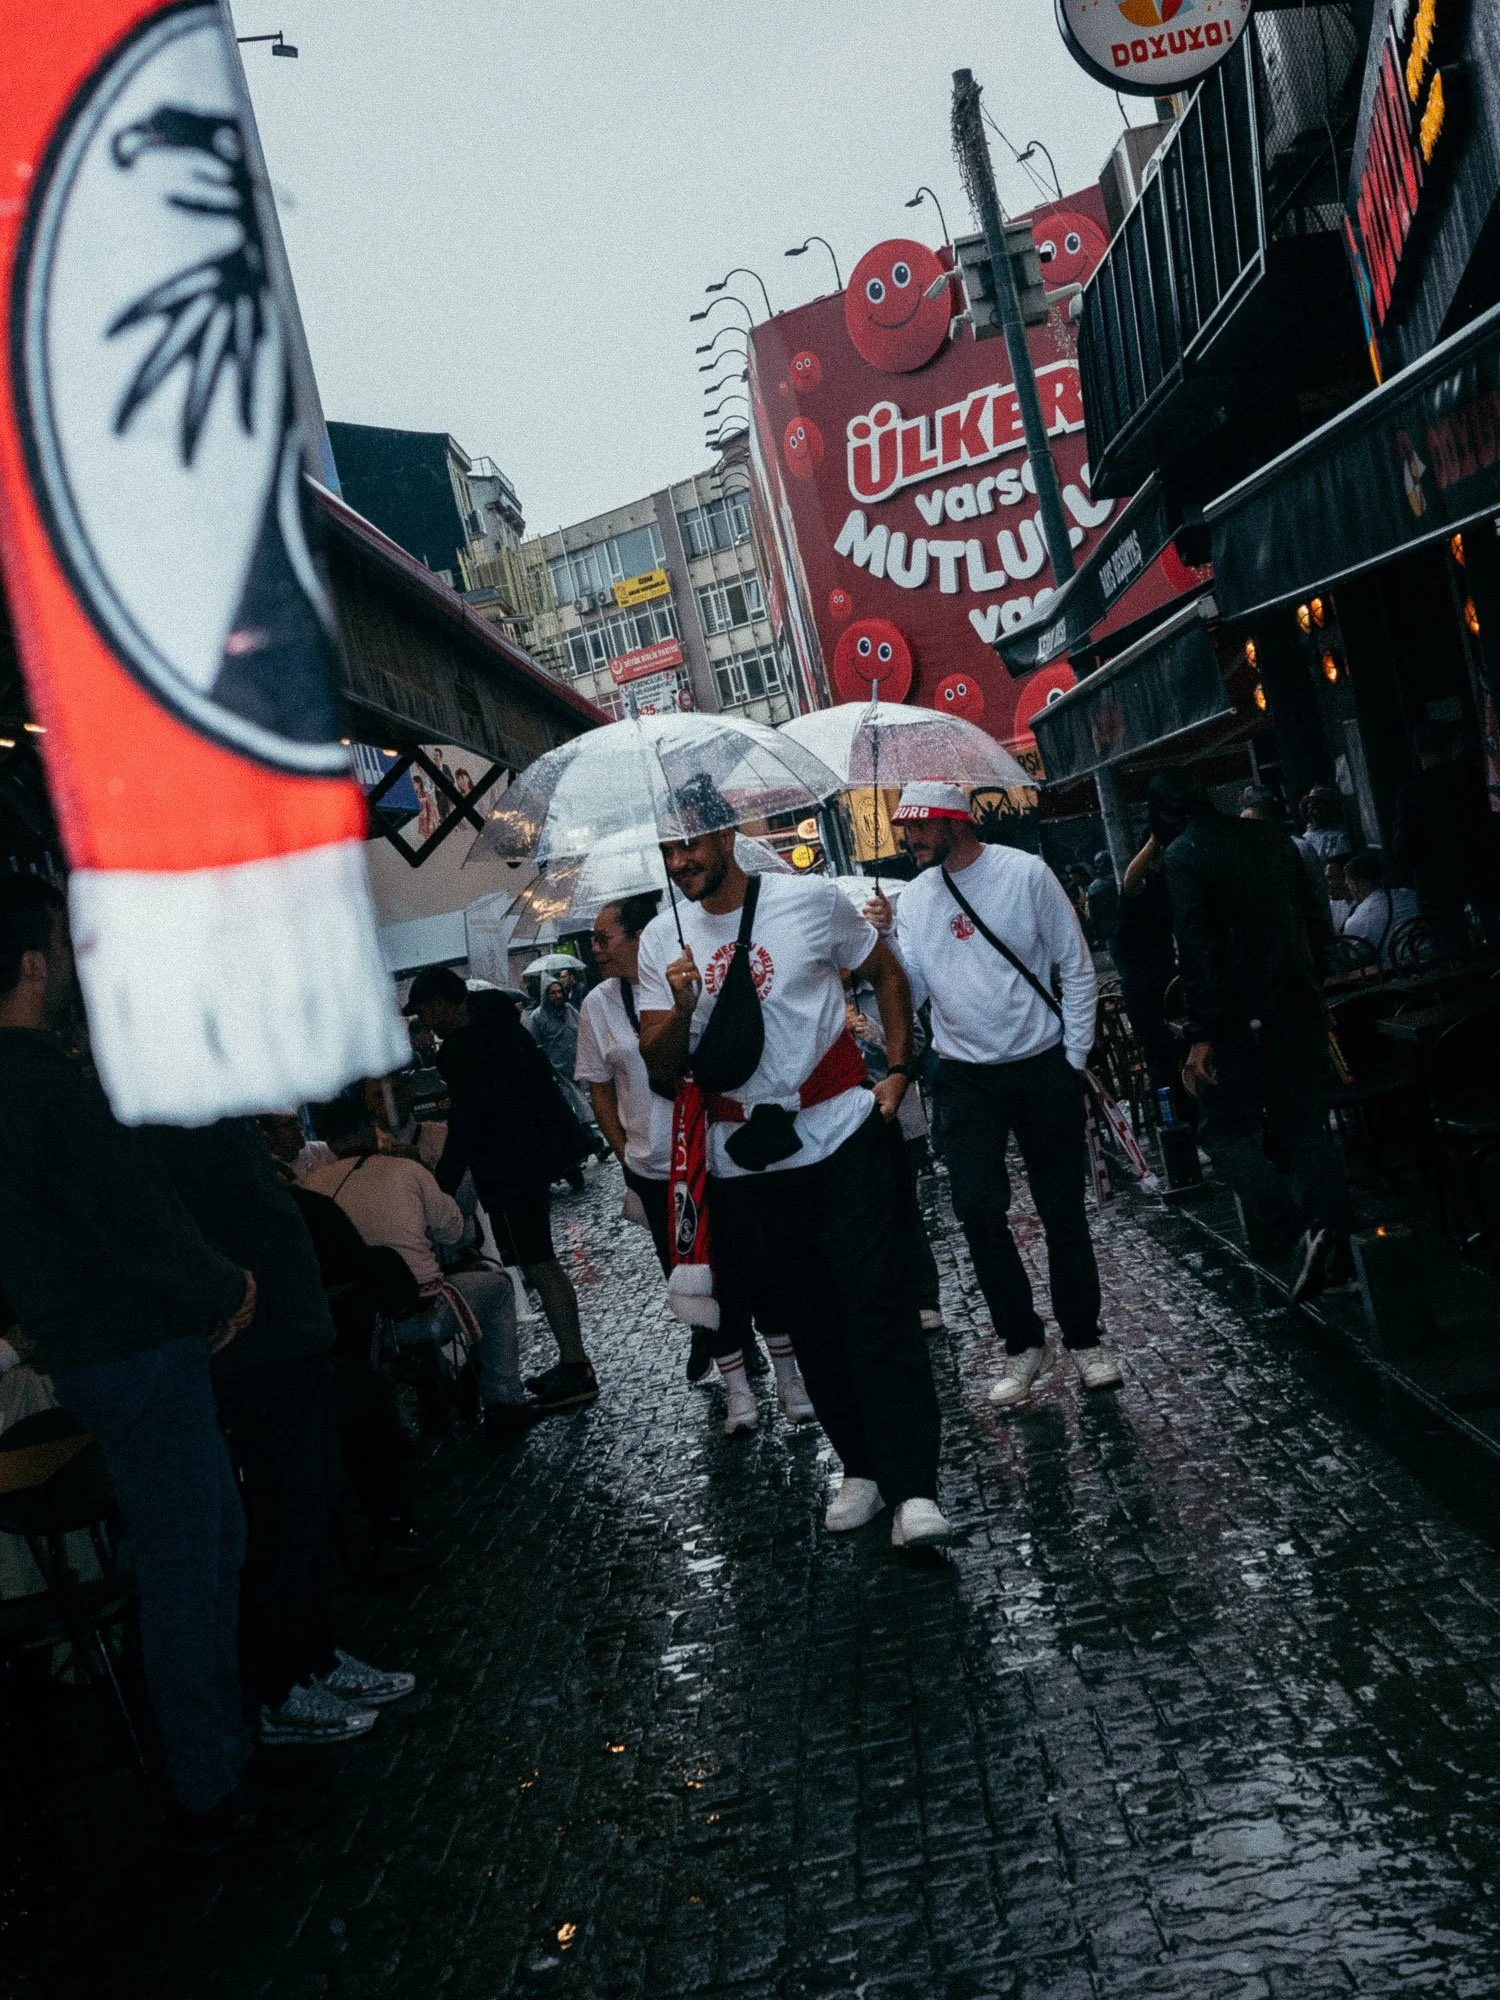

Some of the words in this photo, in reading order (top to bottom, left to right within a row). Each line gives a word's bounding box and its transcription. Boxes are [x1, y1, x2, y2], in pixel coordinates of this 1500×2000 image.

[1111, 19, 1233, 68] DOYUYO!
[847, 359, 1085, 503] ÜLKER
[705, 963, 717, 995] KEIN
[756, 946, 775, 975] WEIT
